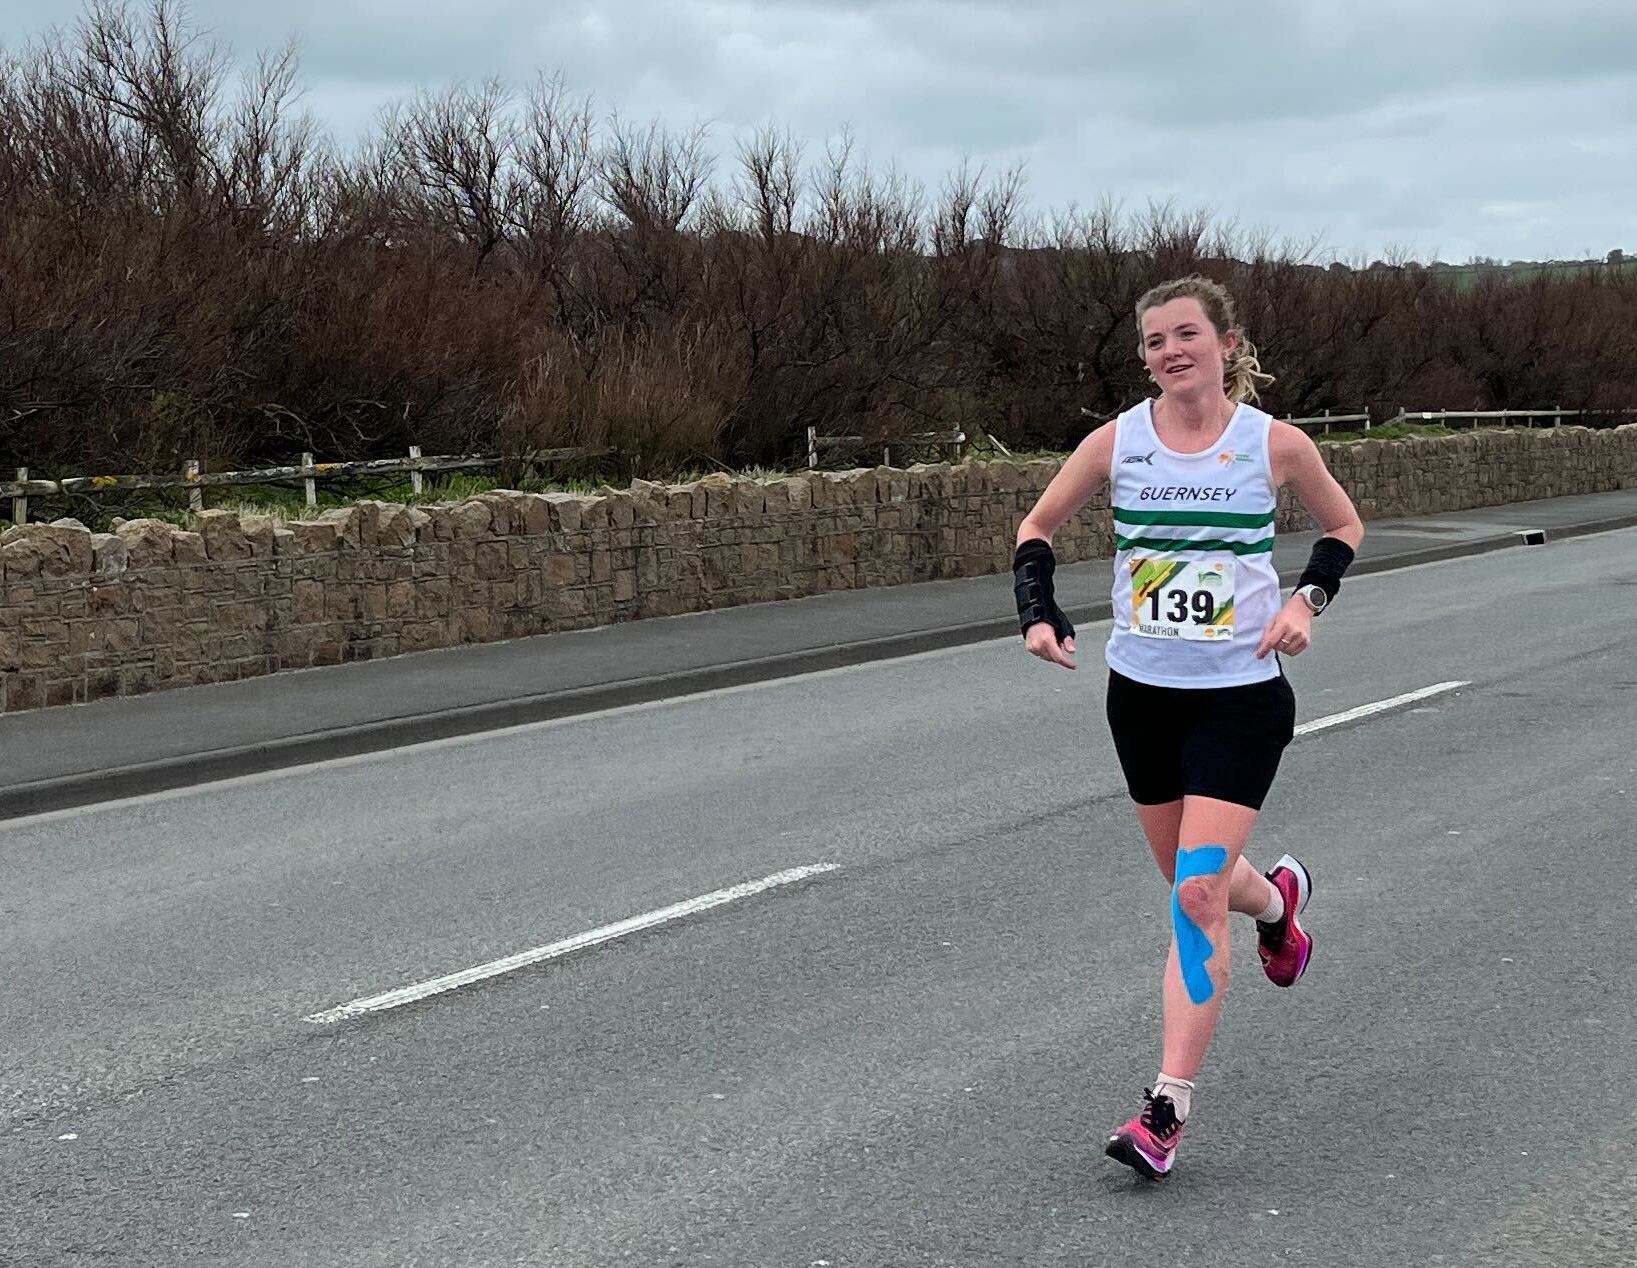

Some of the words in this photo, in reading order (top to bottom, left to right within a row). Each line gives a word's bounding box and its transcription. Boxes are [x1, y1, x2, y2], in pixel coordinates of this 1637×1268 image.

[1140, 486, 1237, 502] GUERNSEY
[1146, 588, 1214, 624] 139
[1139, 624, 1179, 637] MARATHON
